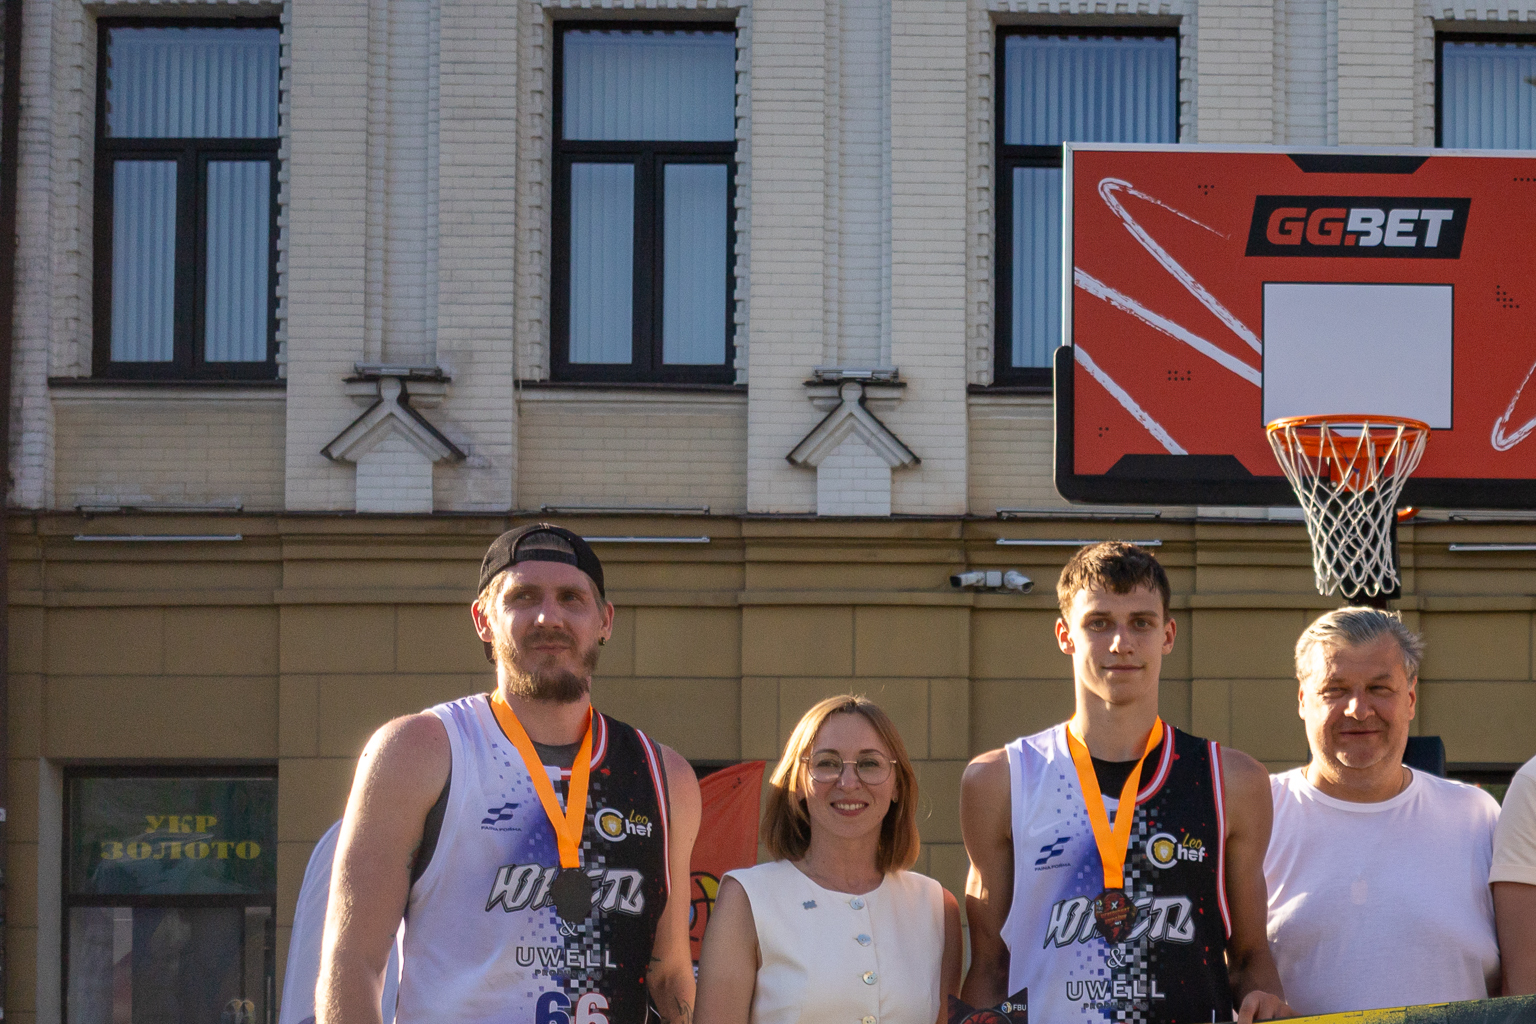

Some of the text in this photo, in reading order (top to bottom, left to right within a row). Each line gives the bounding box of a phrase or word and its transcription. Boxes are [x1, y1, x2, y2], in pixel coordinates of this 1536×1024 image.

[145, 815, 217, 833] УКР
[629, 809, 649, 823] Leo
[1183, 833, 1202, 848] Leo
[100, 841, 261, 860] ЗОЛОТО
[516, 946, 617, 968] UWELL
[1107, 947, 1126, 968] &
[1066, 980, 1165, 1001] UWELL
